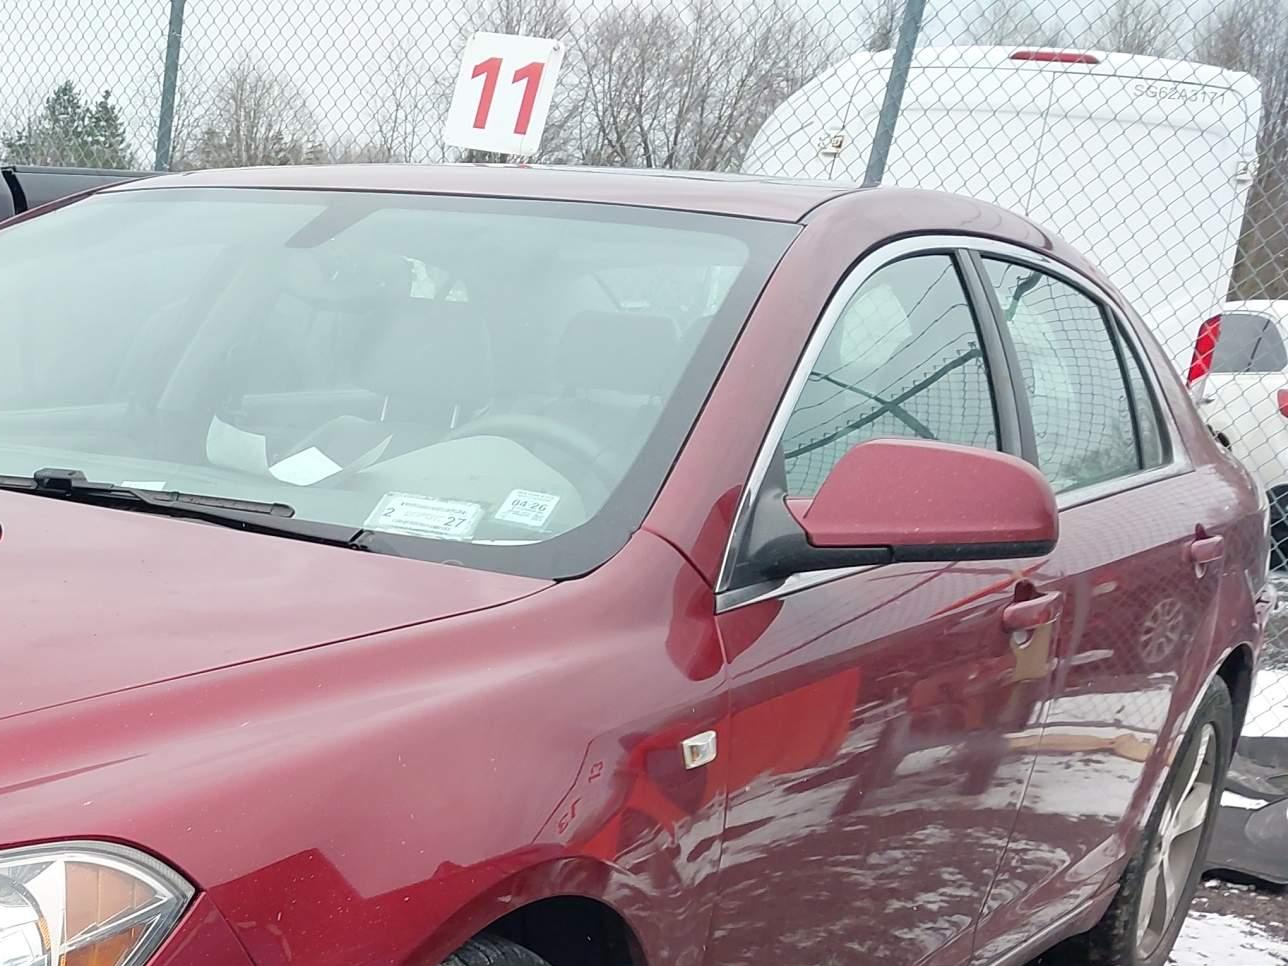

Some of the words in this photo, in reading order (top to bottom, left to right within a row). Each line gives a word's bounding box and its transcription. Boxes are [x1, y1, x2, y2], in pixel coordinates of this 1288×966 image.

[471, 57, 545, 135] 11
[383, 507, 395, 517] 2
[443, 516, 467, 527] 27
